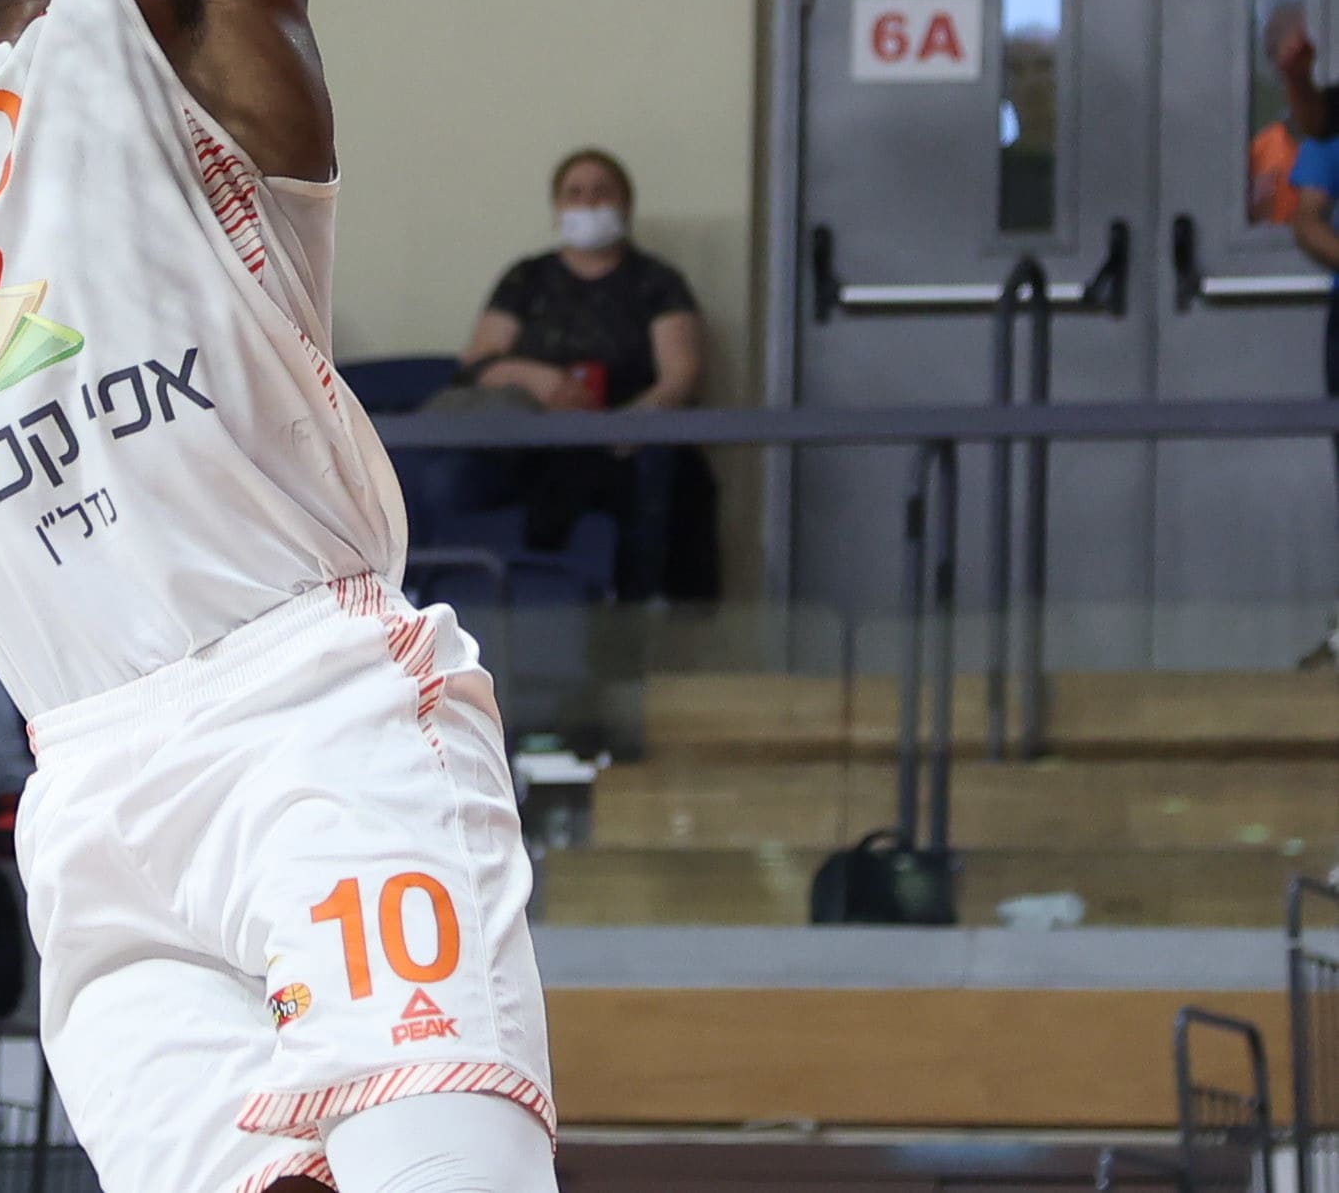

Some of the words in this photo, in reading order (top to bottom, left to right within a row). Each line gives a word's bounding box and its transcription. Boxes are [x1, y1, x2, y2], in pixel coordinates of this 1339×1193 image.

[871, 9, 965, 64] 6A
[81, 347, 216, 440] אפי
[309, 871, 461, 1001] 10
[391, 1016, 462, 1047] PEAK
